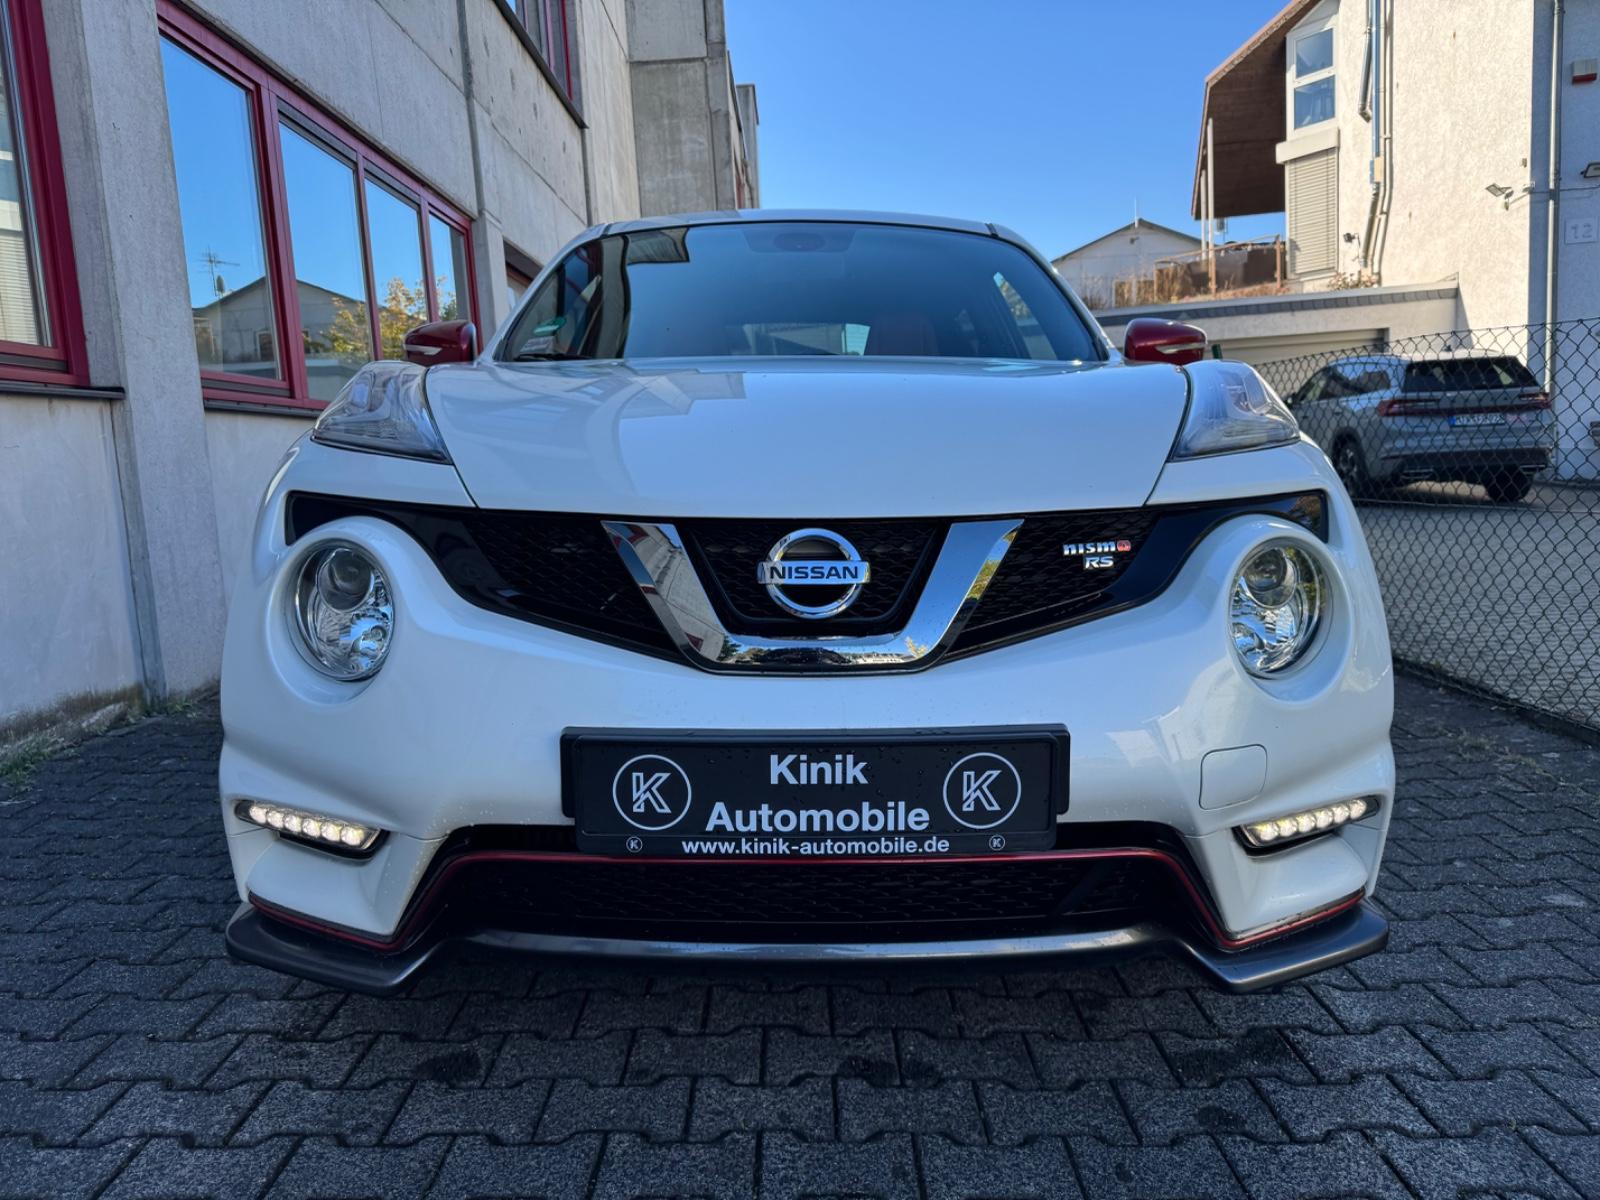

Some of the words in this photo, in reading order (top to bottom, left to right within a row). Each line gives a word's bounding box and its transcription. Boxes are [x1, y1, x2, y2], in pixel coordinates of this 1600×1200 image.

[1570, 223, 1593, 239] 12
[1063, 540, 1132, 555] nismo
[1084, 556, 1114, 569] RS
[769, 566, 859, 580] NISSAN
[769, 753, 869, 785] Kinik
[631, 772, 672, 814] K
[961, 770, 1002, 812] K
[705, 800, 931, 832] Automobile
[681, 835, 951, 855] www.kinik-automobile.de
